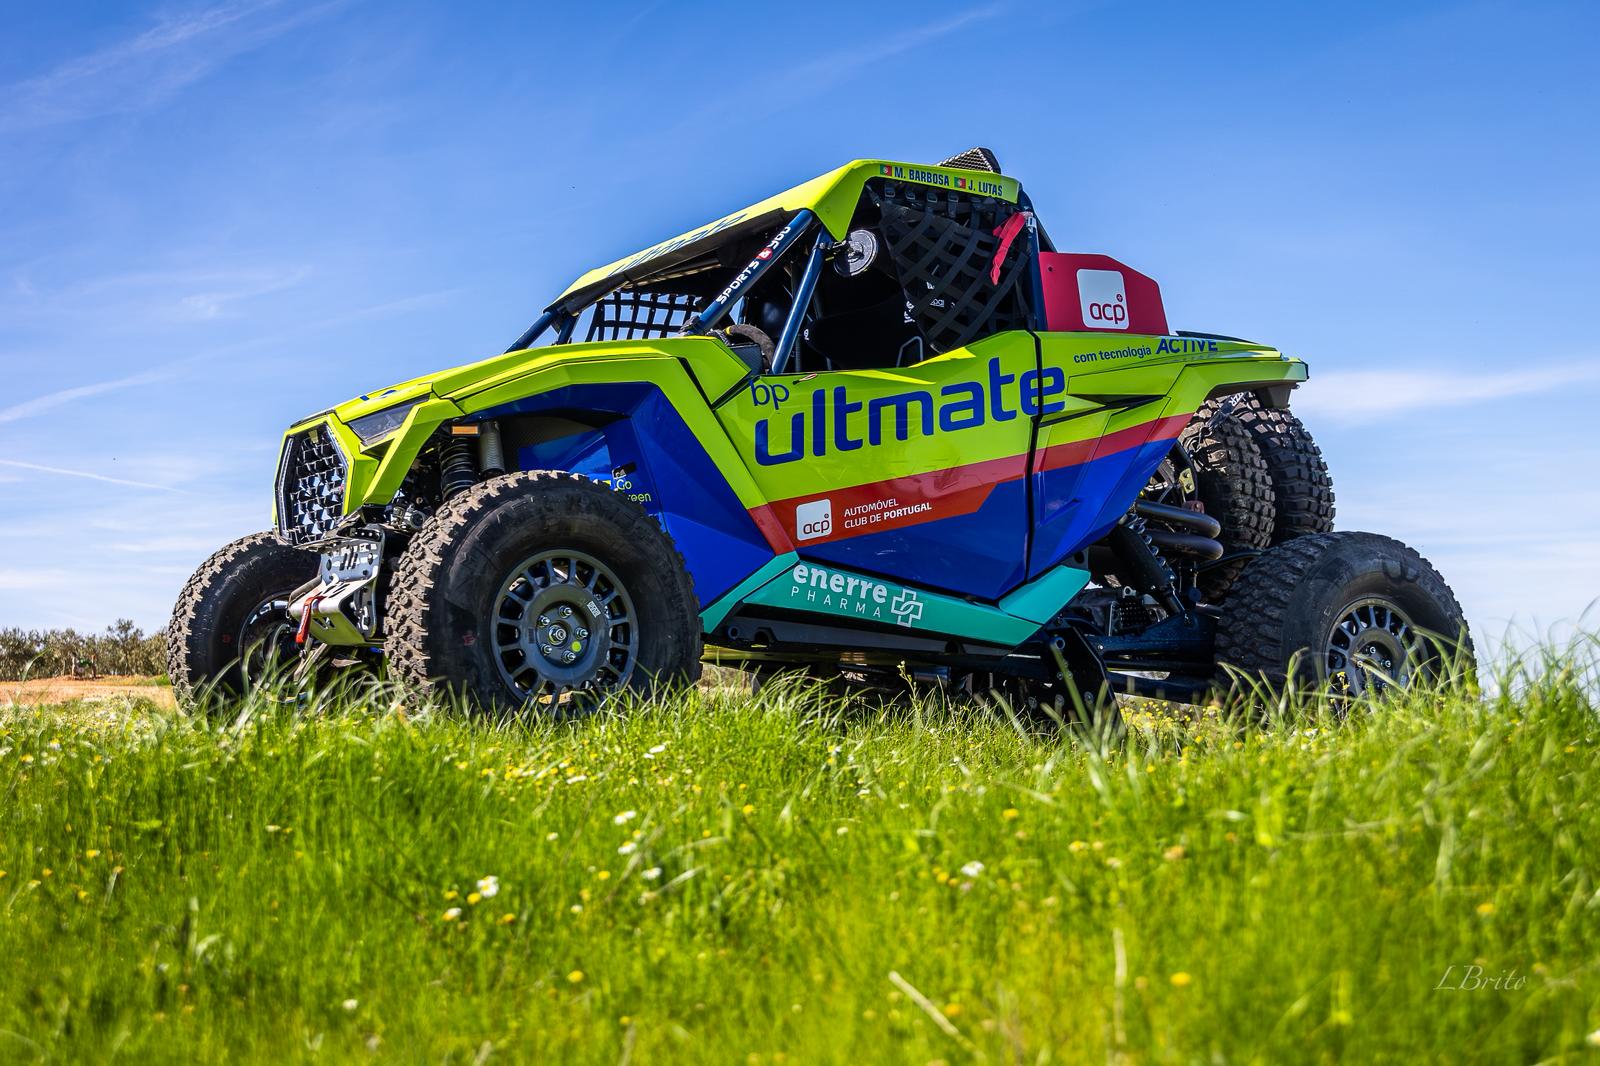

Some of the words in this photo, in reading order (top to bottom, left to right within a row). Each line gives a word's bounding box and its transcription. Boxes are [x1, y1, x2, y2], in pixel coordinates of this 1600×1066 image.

[894, 166, 906, 179] M.
[909, 168, 950, 186] BARBOSA
[968, 180, 976, 191] J.
[978, 182, 1003, 196] LUTAS
[715, 260, 760, 305] SPORTS
[766, 226, 792, 250] YOU
[1089, 302, 1125, 324] acp
[1073, 353, 1097, 364] com
[1098, 345, 1152, 361] tecnologia
[1156, 338, 1218, 354] ACTIVE
[751, 378, 790, 410] bp
[844, 498, 899, 518] AUTOMÓVEL
[844, 518, 868, 529] CLUB
[870, 514, 882, 524] DE
[883, 502, 932, 520] PORTUGAL
[803, 519, 830, 535] acp
[792, 564, 888, 604] enerre
[791, 586, 881, 618] PHARMA
